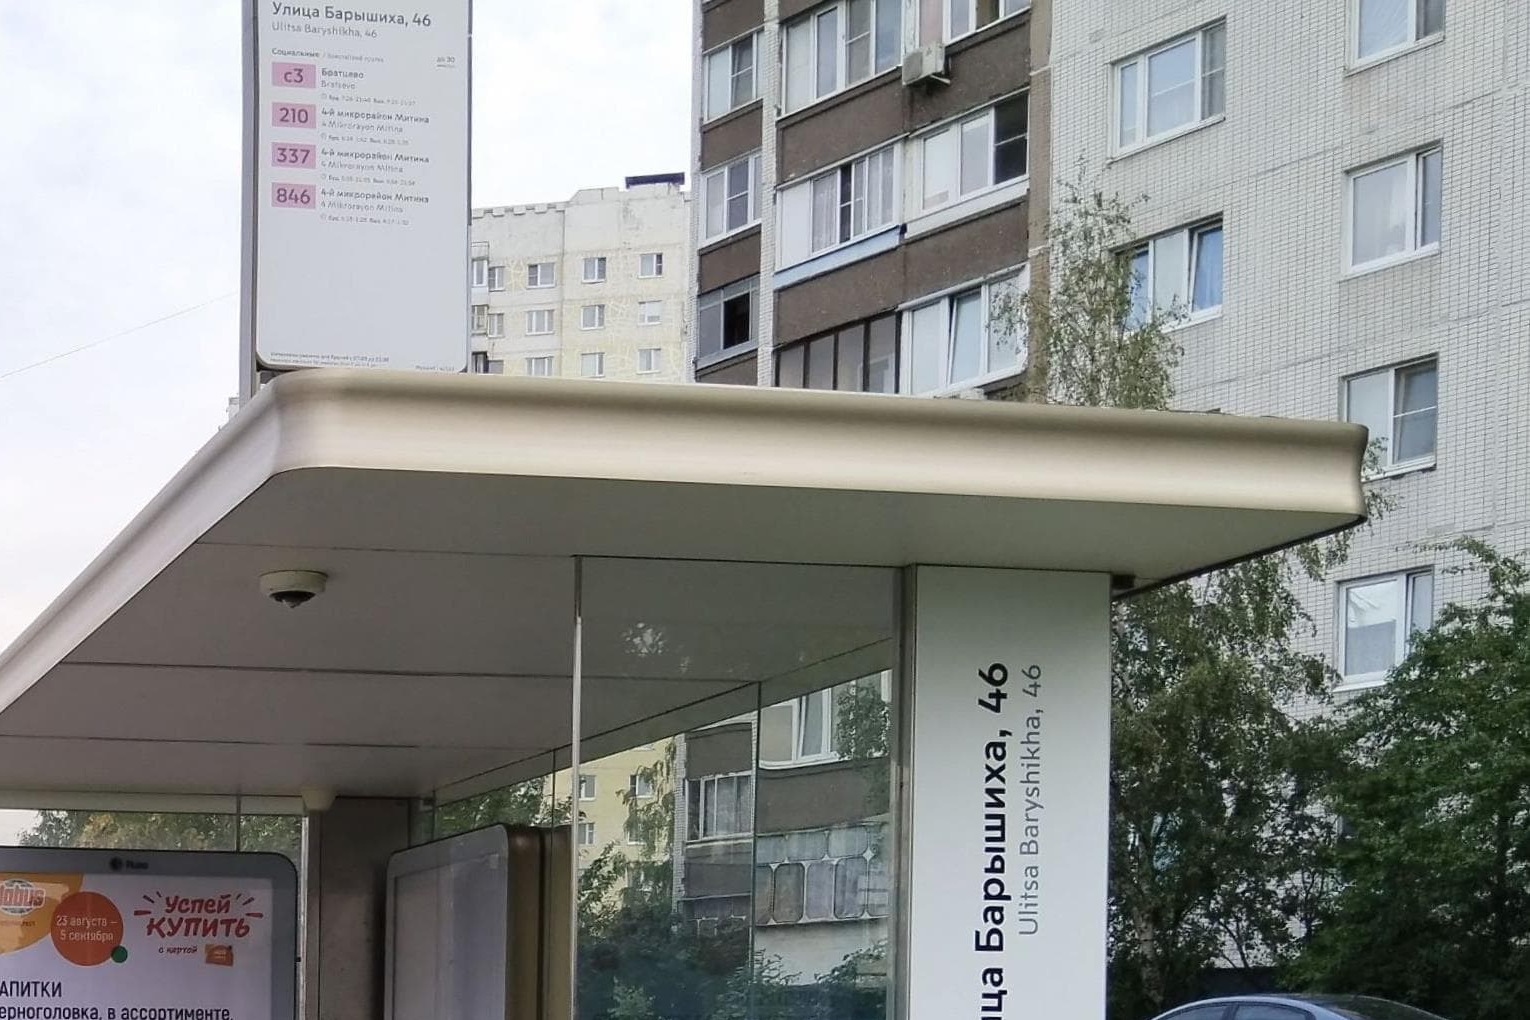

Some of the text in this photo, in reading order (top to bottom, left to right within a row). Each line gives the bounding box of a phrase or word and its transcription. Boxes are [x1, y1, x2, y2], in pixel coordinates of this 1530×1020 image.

[272, 1, 431, 27] Улица Барышиха, 46
[271, 21, 378, 39] Ulitsa Baryshikha, 46
[283, 68, 304, 84] с3
[279, 107, 309, 124] 210
[277, 147, 310, 164] 337
[276, 187, 311, 204] 846
[978, 662, 1008, 714] 46
[1018, 664, 1044, 936] Ulitsa Baryshikha, 46
[974, 728, 1013, 953] Барышиха,
[56, 915, 67, 926] 23
[146, 917, 251, 938] КУПИТЬ
[60, 931, 66, 940] 5
[107, 1007, 116, 1019] в
